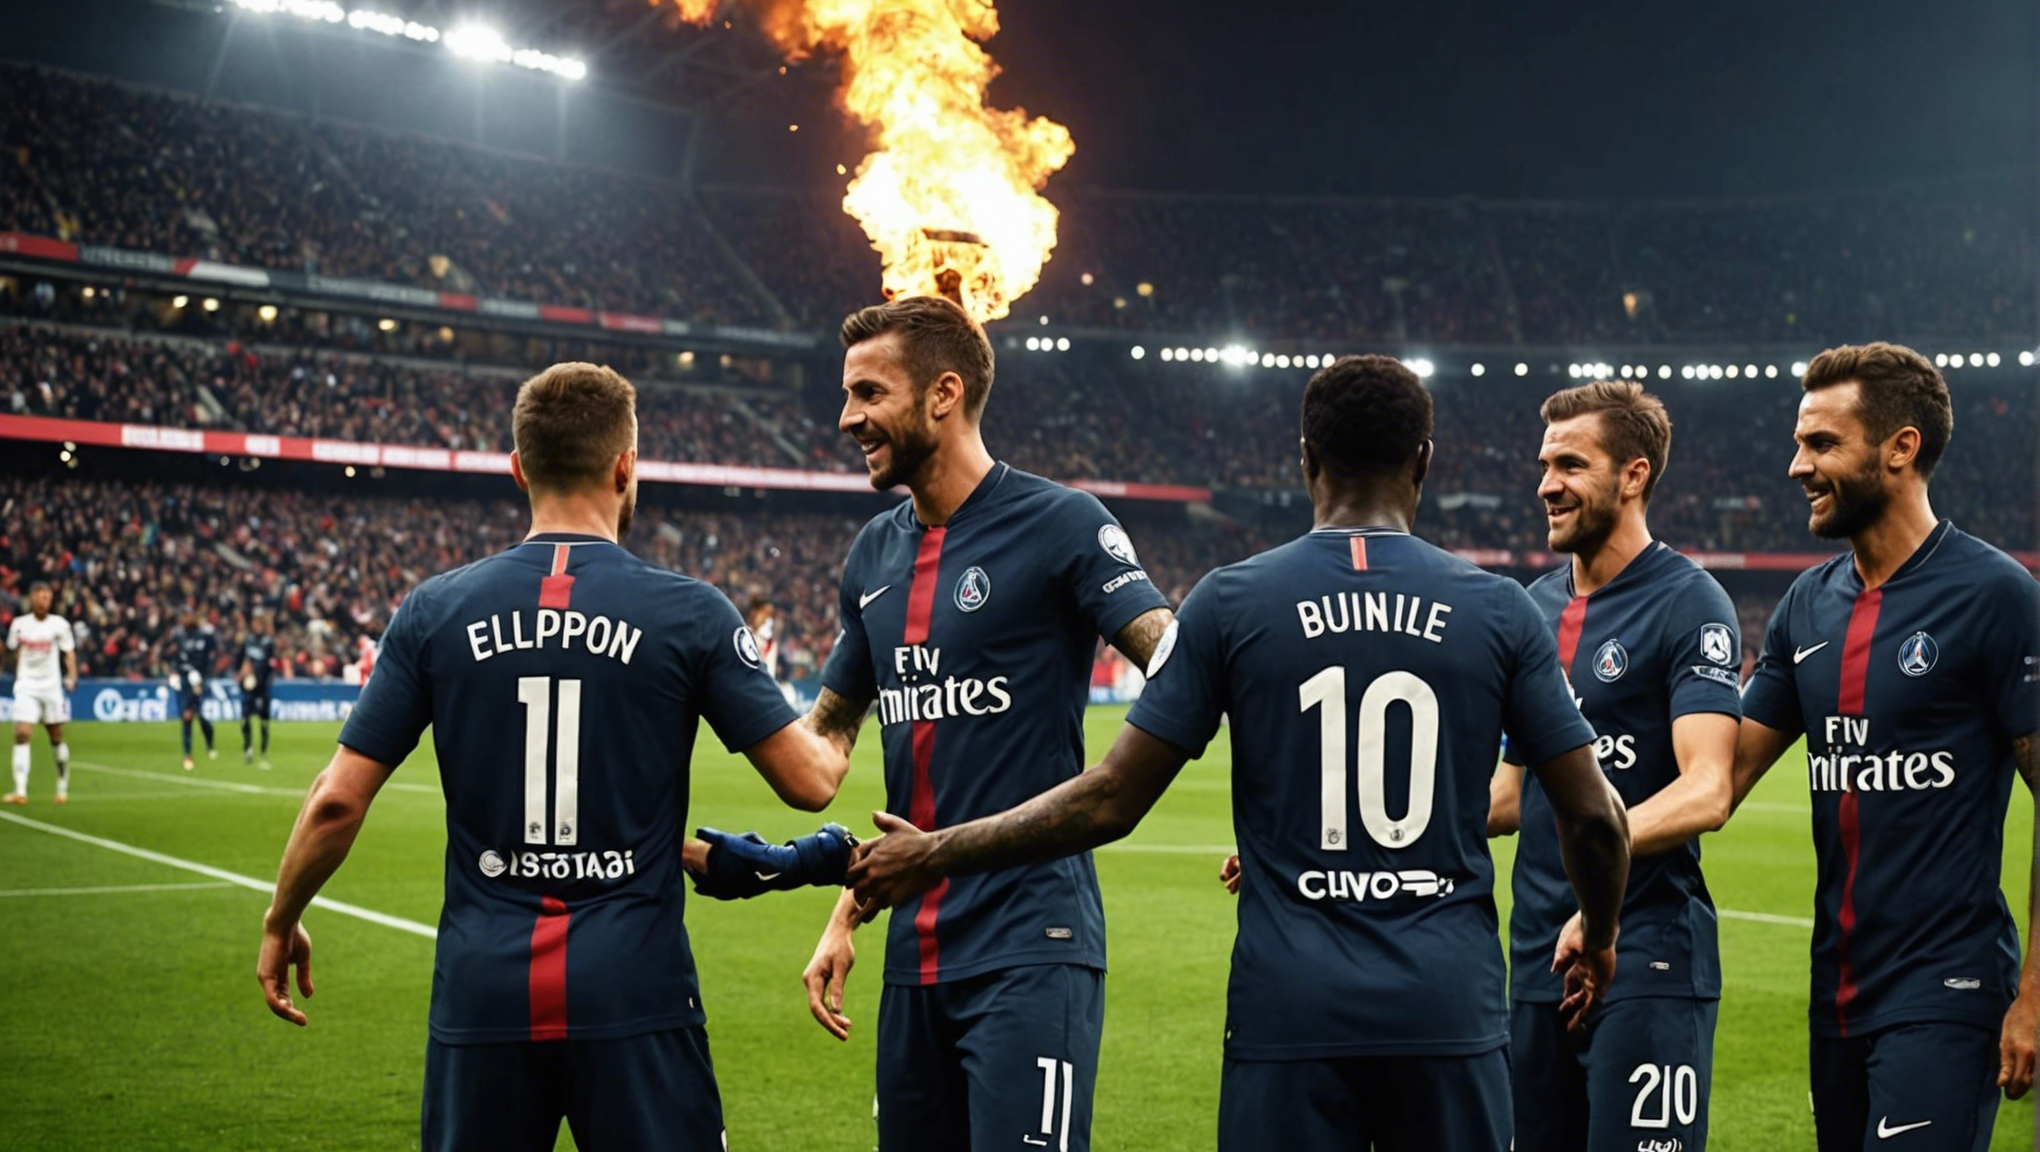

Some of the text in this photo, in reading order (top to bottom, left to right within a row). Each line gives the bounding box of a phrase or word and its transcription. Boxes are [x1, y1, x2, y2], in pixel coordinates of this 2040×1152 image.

[467, 610, 642, 664] ELLPPON
[1297, 592, 1452, 642] BUINILE
[518, 677, 581, 845] 11
[1299, 666, 1438, 850] 10
[1037, 1057, 1072, 1152] 11
